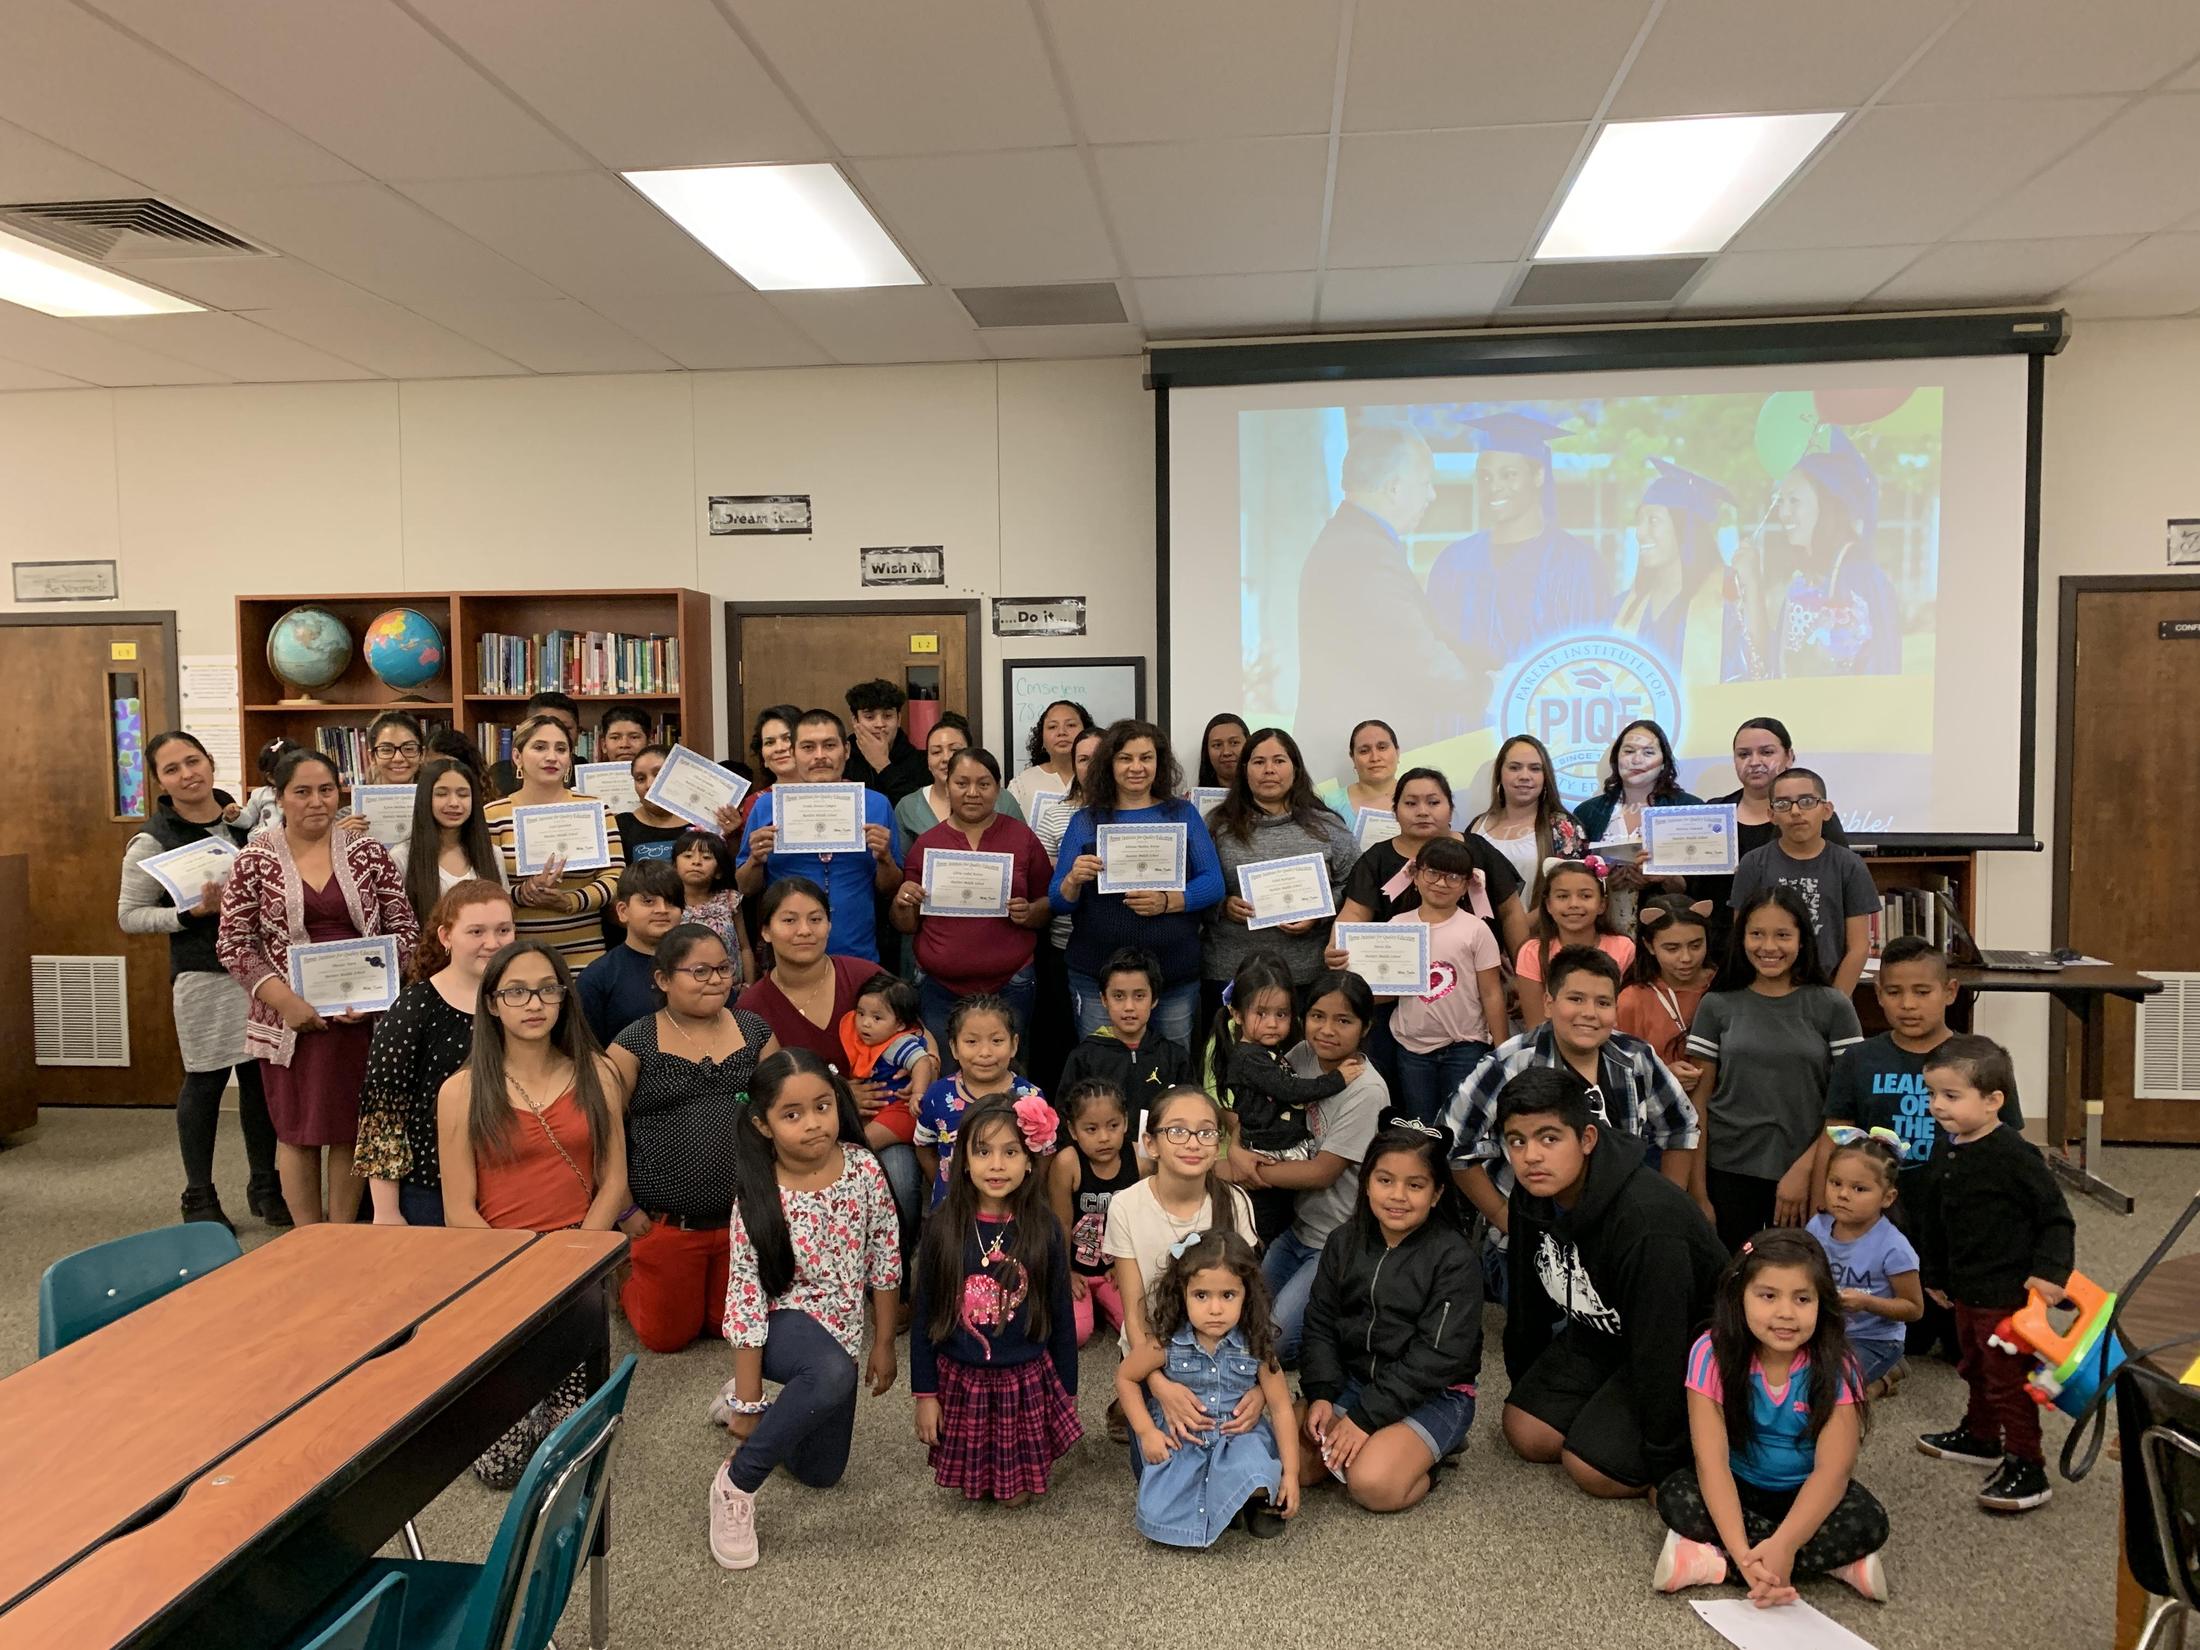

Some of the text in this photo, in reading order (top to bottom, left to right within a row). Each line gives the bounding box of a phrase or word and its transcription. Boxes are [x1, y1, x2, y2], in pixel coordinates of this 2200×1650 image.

[871, 562, 908, 575] Wish
[1515, 644, 1667, 701] PARENT INSTITUTE FOR
[1540, 695, 1642, 745] PIQE
[1559, 752, 1593, 765] SINCE
[1900, 1094, 1930, 1116] OF
[1892, 1114, 1936, 1139] THE
[1080, 1192, 1113, 1213] CO
